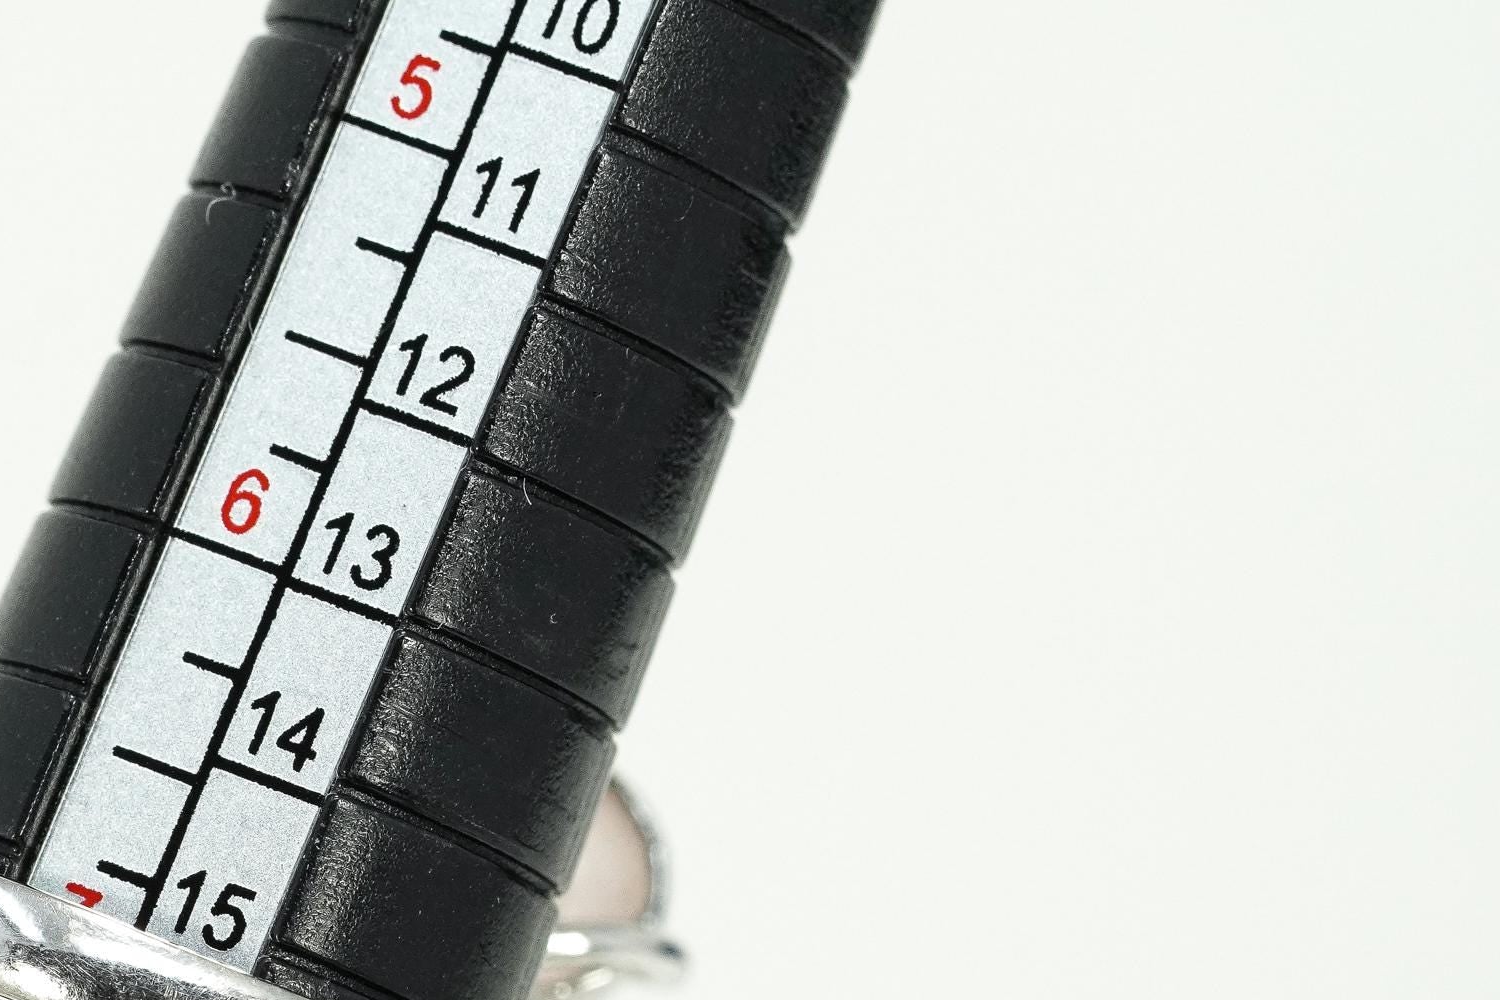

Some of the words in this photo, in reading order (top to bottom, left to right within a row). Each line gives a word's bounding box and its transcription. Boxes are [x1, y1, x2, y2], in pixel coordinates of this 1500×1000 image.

[542, 0, 621, 56] 10
[391, 54, 441, 120] 5
[472, 157, 541, 234] 11
[395, 333, 476, 418] 12
[221, 468, 270, 535] 6
[322, 512, 401, 592] 13
[247, 690, 325, 773] 14
[173, 869, 257, 952] 15
